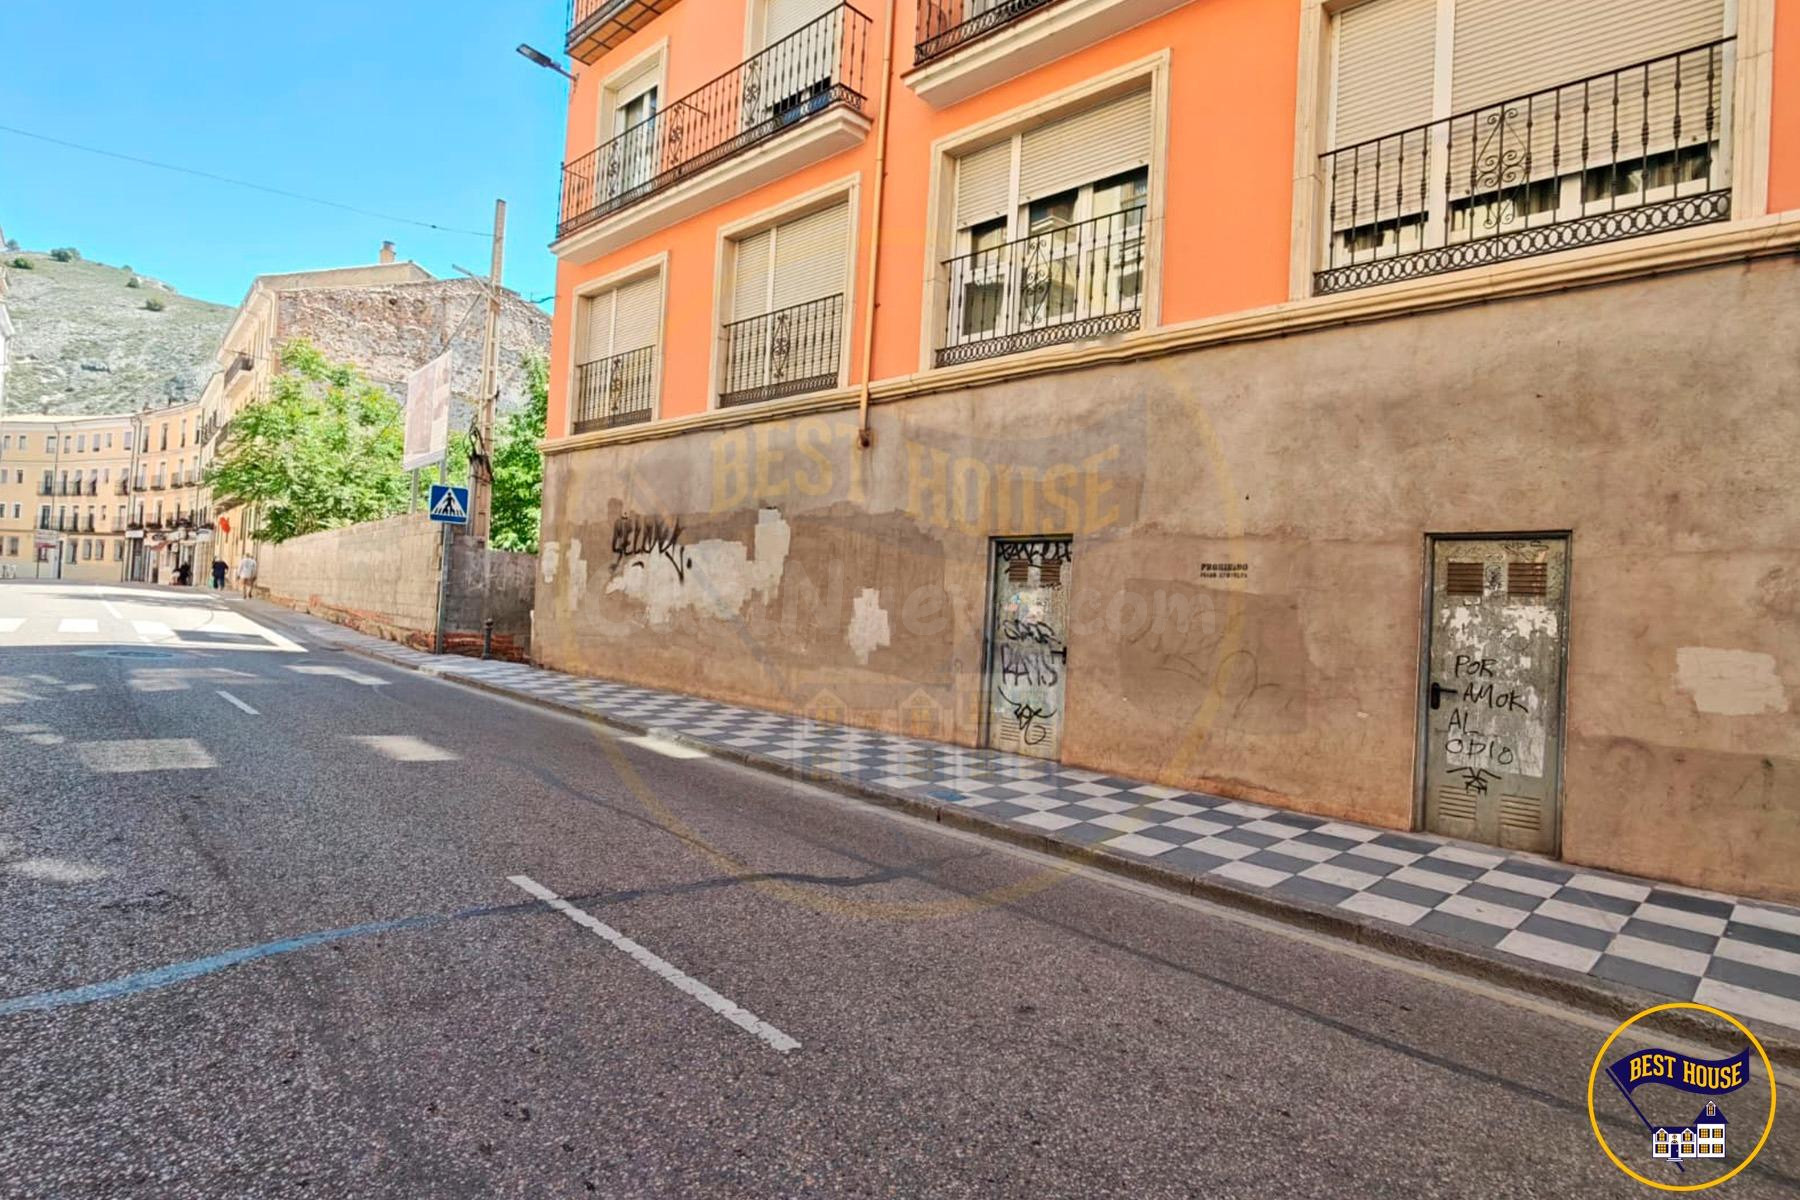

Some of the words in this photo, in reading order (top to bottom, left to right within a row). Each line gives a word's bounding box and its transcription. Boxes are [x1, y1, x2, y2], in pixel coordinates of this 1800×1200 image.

[1454, 655, 1497, 678] POR
[1448, 708, 1480, 735] AL
[1445, 739, 1514, 765] ODIO
